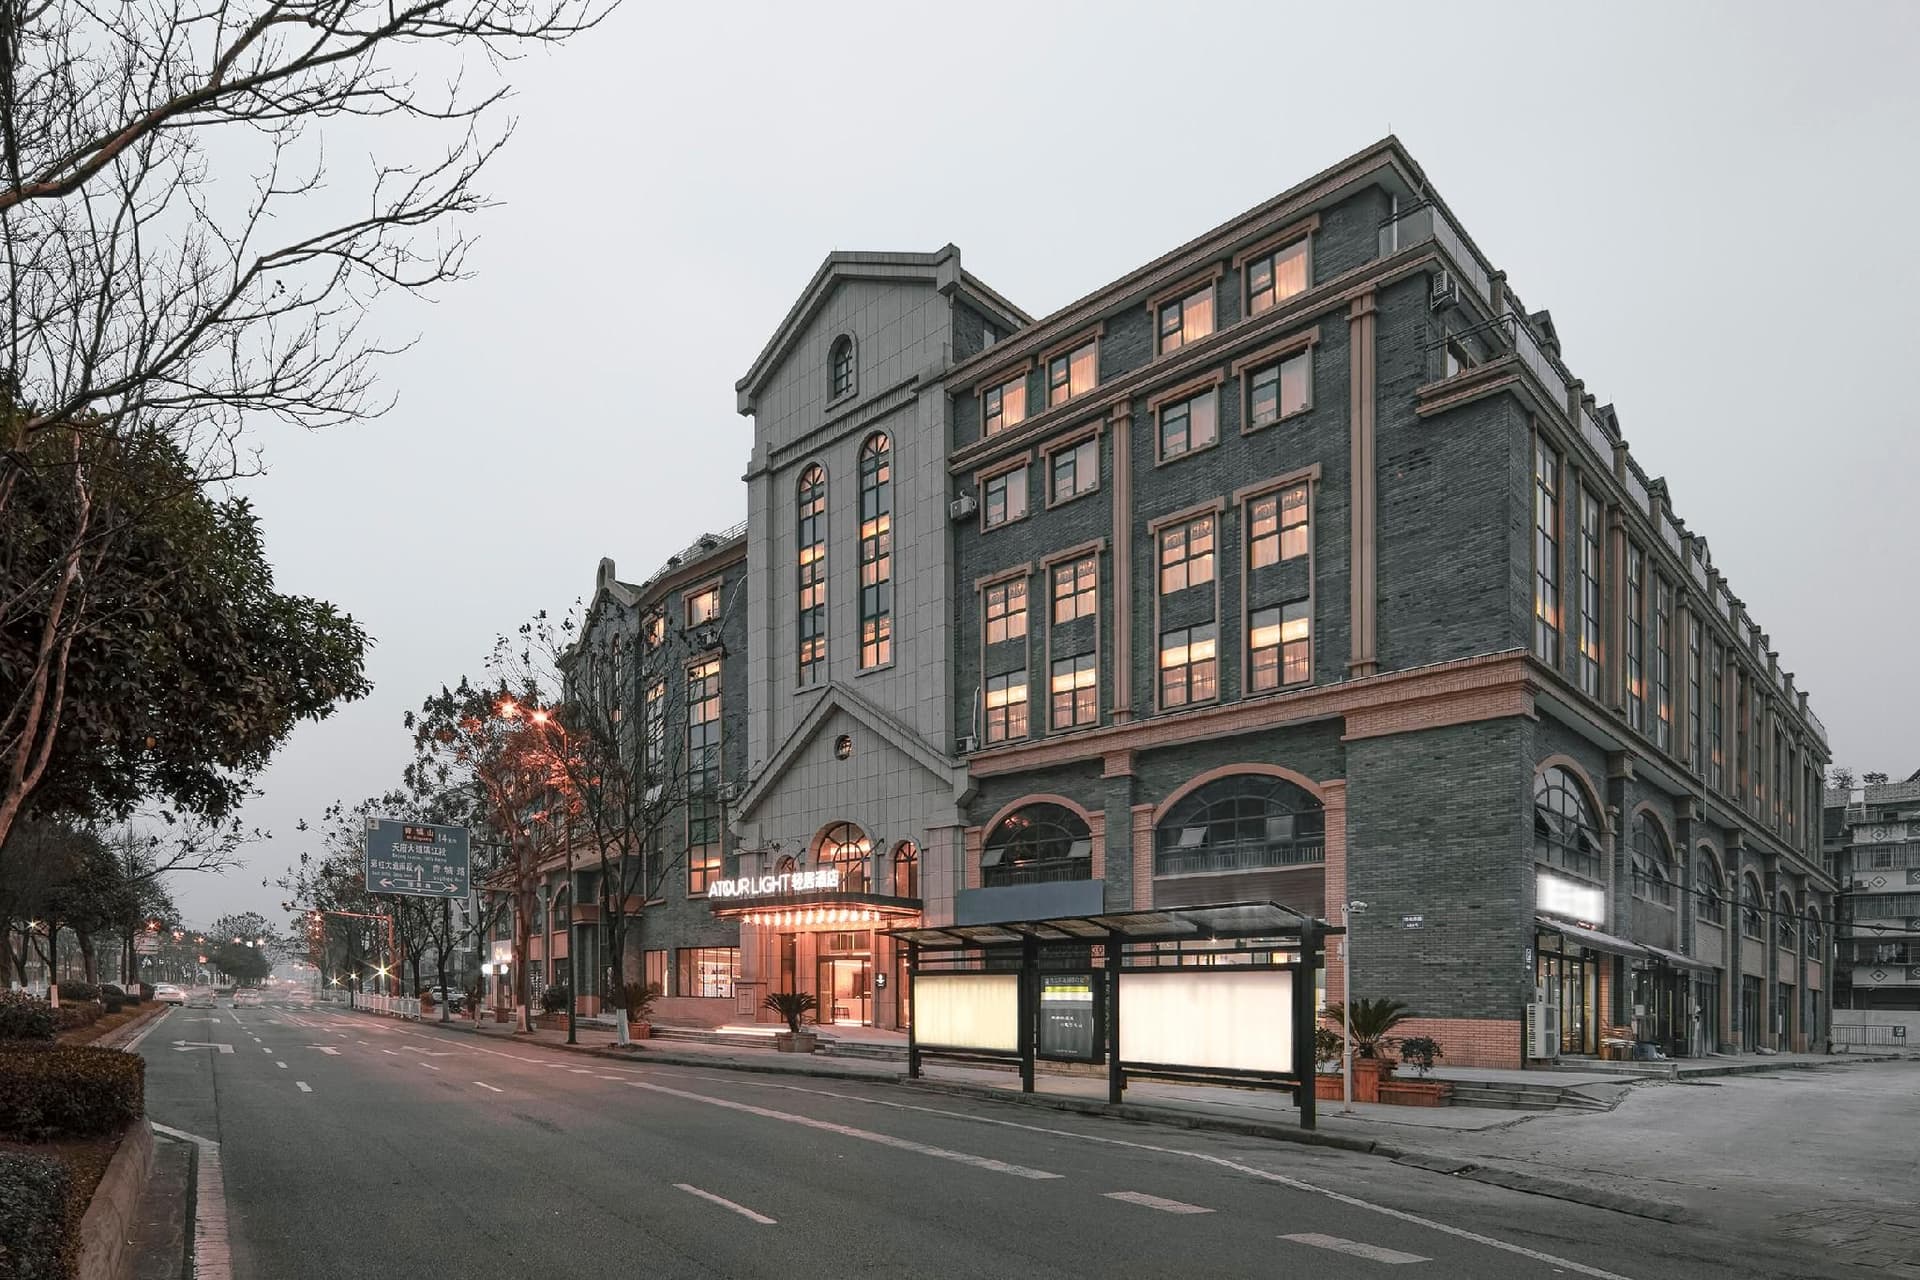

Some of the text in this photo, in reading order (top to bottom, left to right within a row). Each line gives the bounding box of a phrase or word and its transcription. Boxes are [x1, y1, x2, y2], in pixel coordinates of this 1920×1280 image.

[708, 869, 840, 898] ATOUR LIGHT 轻居酒店
